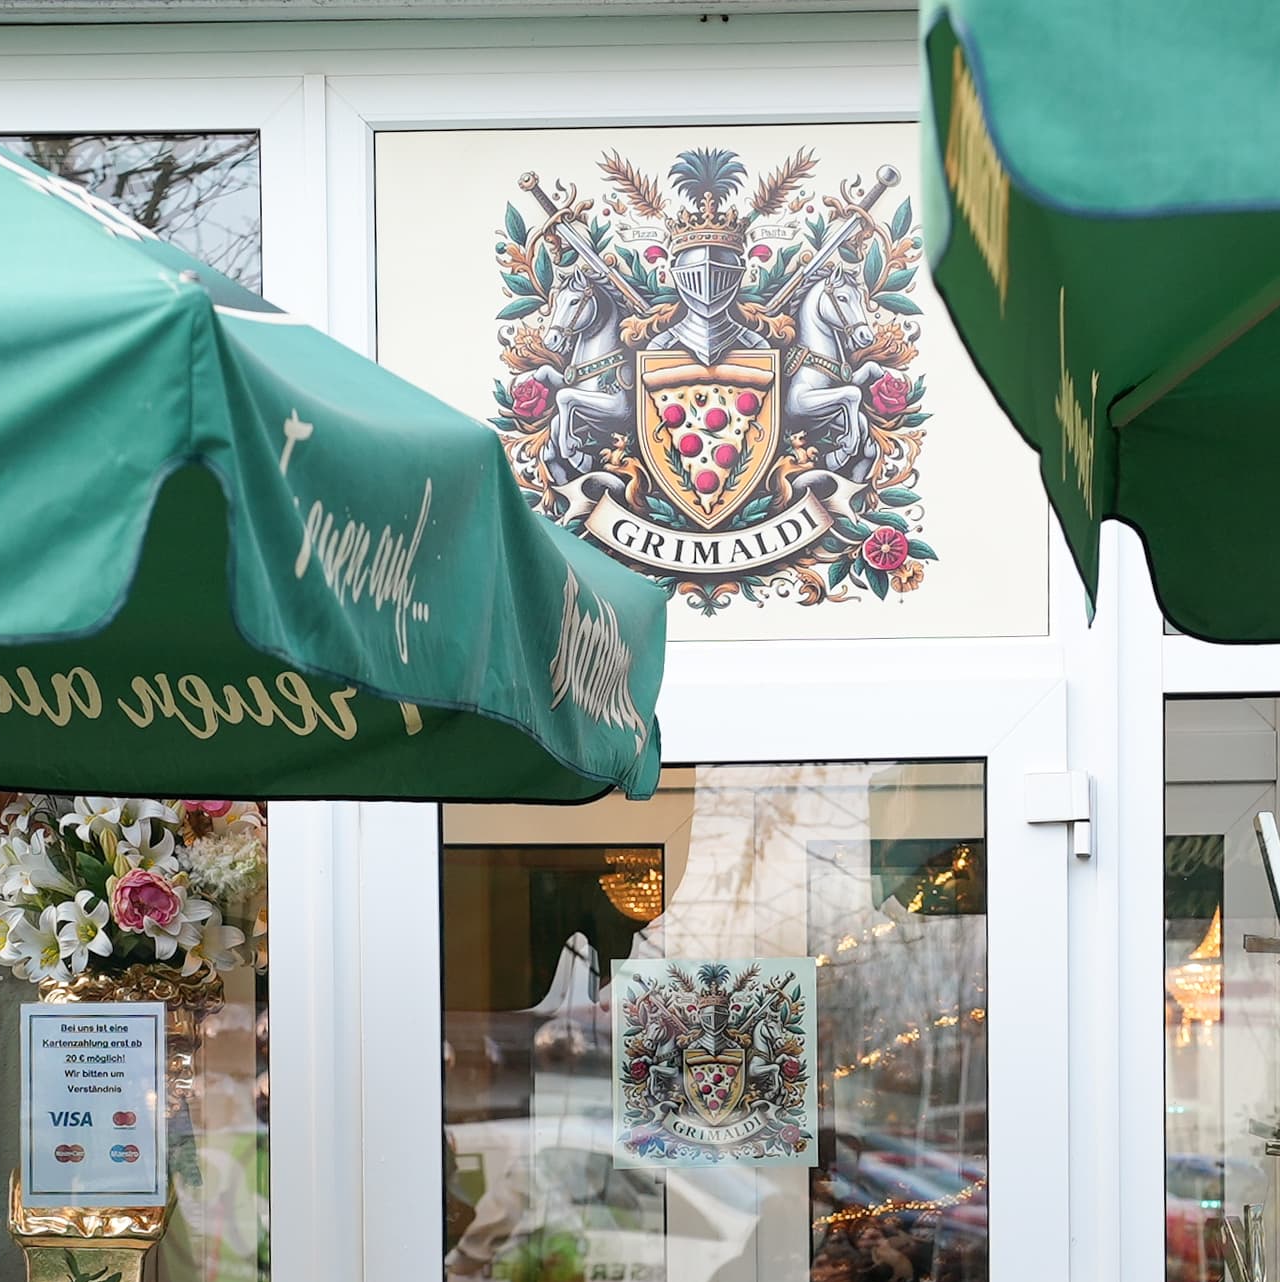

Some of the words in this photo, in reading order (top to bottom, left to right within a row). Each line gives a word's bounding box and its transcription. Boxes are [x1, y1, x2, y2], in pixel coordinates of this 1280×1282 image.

[632, 230, 658, 239] Pizza
[611, 506, 820, 566] GRIMALDI
[78, 1025, 94, 1033] uns
[109, 1023, 129, 1032] eine
[42, 1039, 109, 1049] Kartenzahlung
[110, 1039, 129, 1048] erst
[131, 1039, 143, 1048] ab
[65, 1054, 77, 1063] 20
[86, 1053, 126, 1064] möglich!
[64, 1069, 80, 1078] Wir
[82, 1069, 108, 1078] bitten
[67, 1084, 122, 1093] Verständnis
[48, 1111, 93, 1127] VISA
[673, 1115, 762, 1140] GRIMALDI
